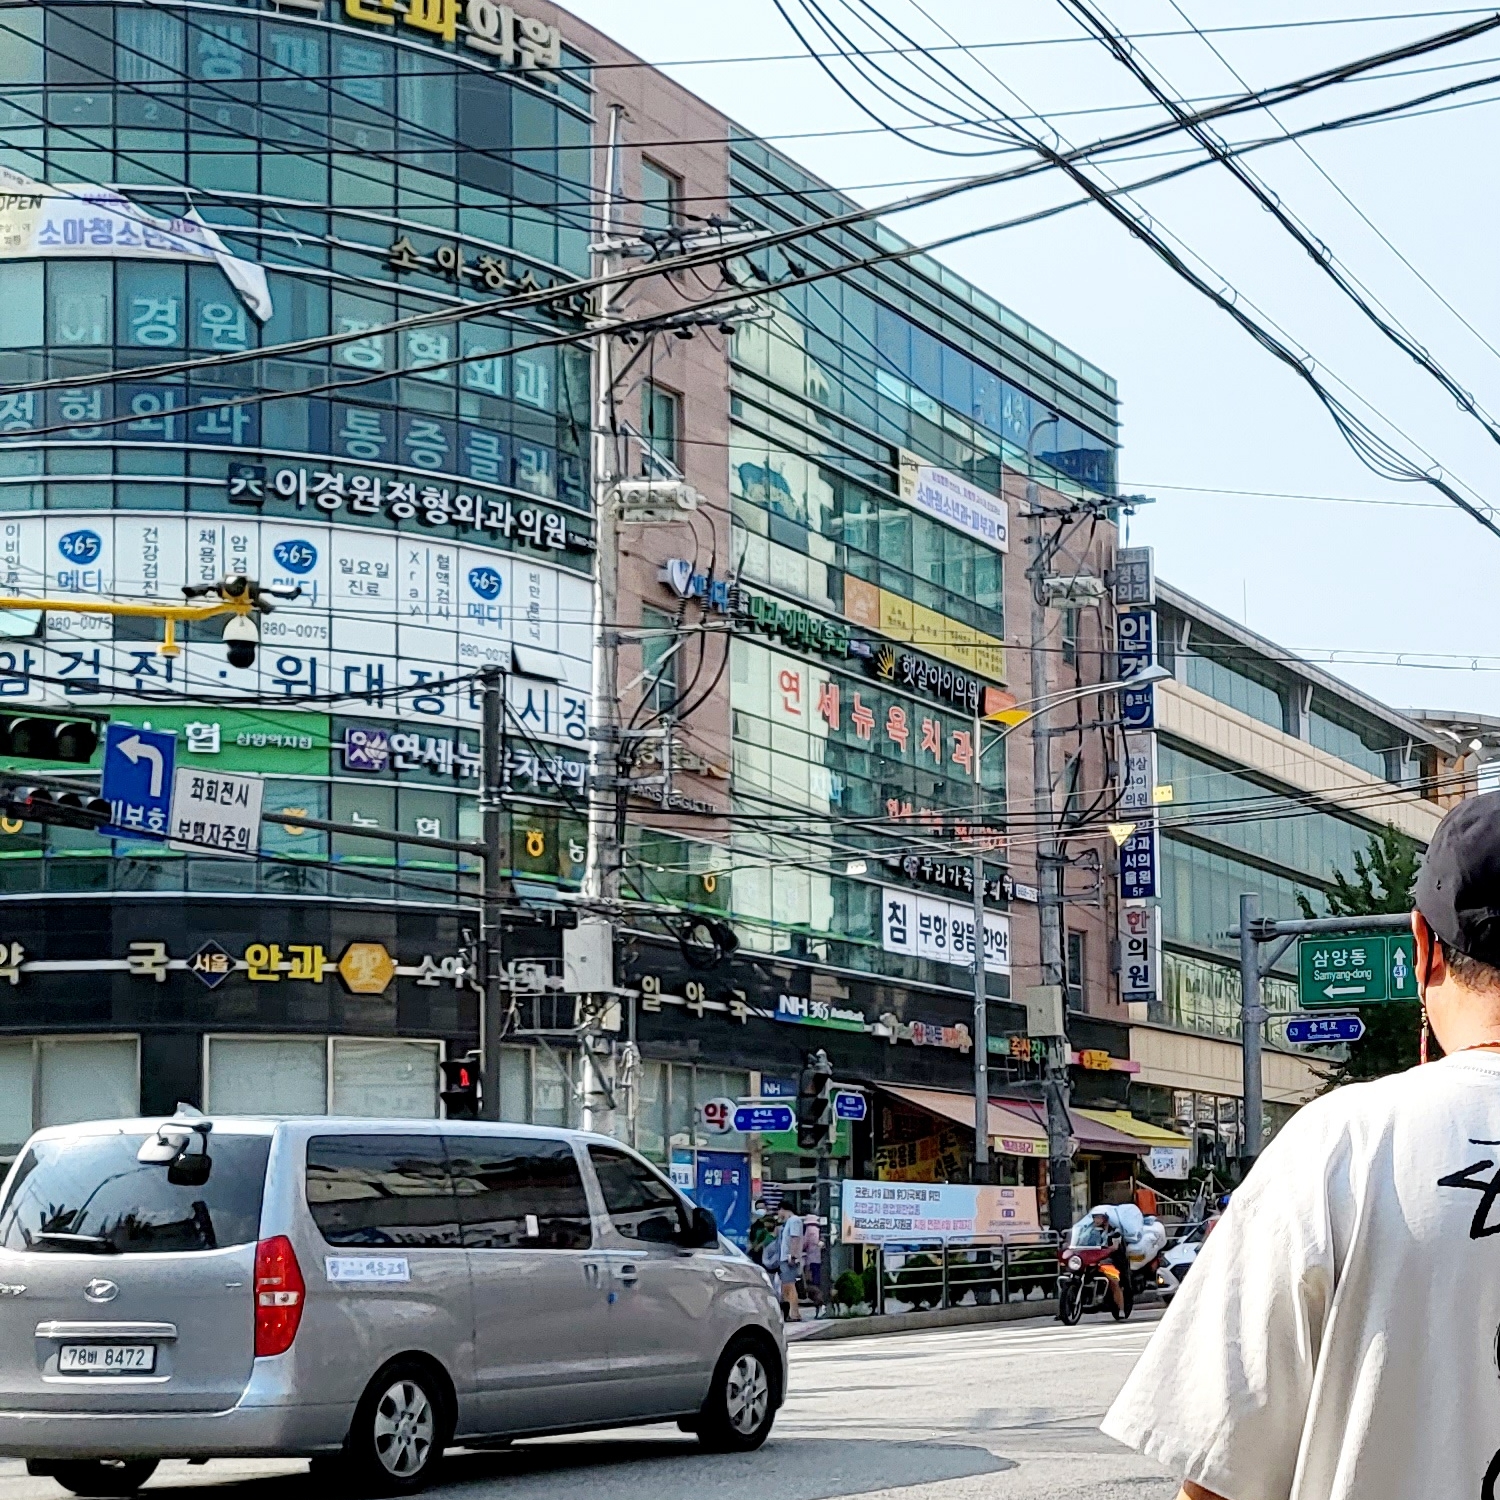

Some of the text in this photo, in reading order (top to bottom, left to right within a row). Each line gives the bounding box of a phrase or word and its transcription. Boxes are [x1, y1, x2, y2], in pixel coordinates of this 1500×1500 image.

[340, 316, 550, 410] 정형외과
[60, 536, 102, 556] 365
[141, 527, 160, 598] 건강검진
[338, 556, 390, 579] 일요일
[57, 568, 102, 593] 메디
[347, 578, 381, 598] 진료
[902, 653, 981, 712] 햇살아이의원
[271, 653, 588, 742] 위대장시경
[779, 668, 974, 776] 연세뉴욕치과
[190, 776, 250, 806] 좌회전시
[887, 900, 908, 946] 침
[919, 912, 949, 949] 부항
[127, 942, 166, 983] 국
[1126, 911, 1151, 989] 한의원
[1312, 948, 1367, 968] 삼양동
[194, 953, 229, 974] 서울
[244, 943, 326, 984] 안과
[1313, 969, 1372, 982] Samyang-dong
[1394, 967, 1407, 976] 41
[780, 994, 809, 1018] NH
[1349, 1024, 1359, 1033] 57
[764, 1083, 781, 1095] NH
[703, 1102, 729, 1130] 약
[104, 1349, 145, 1366] 8472
